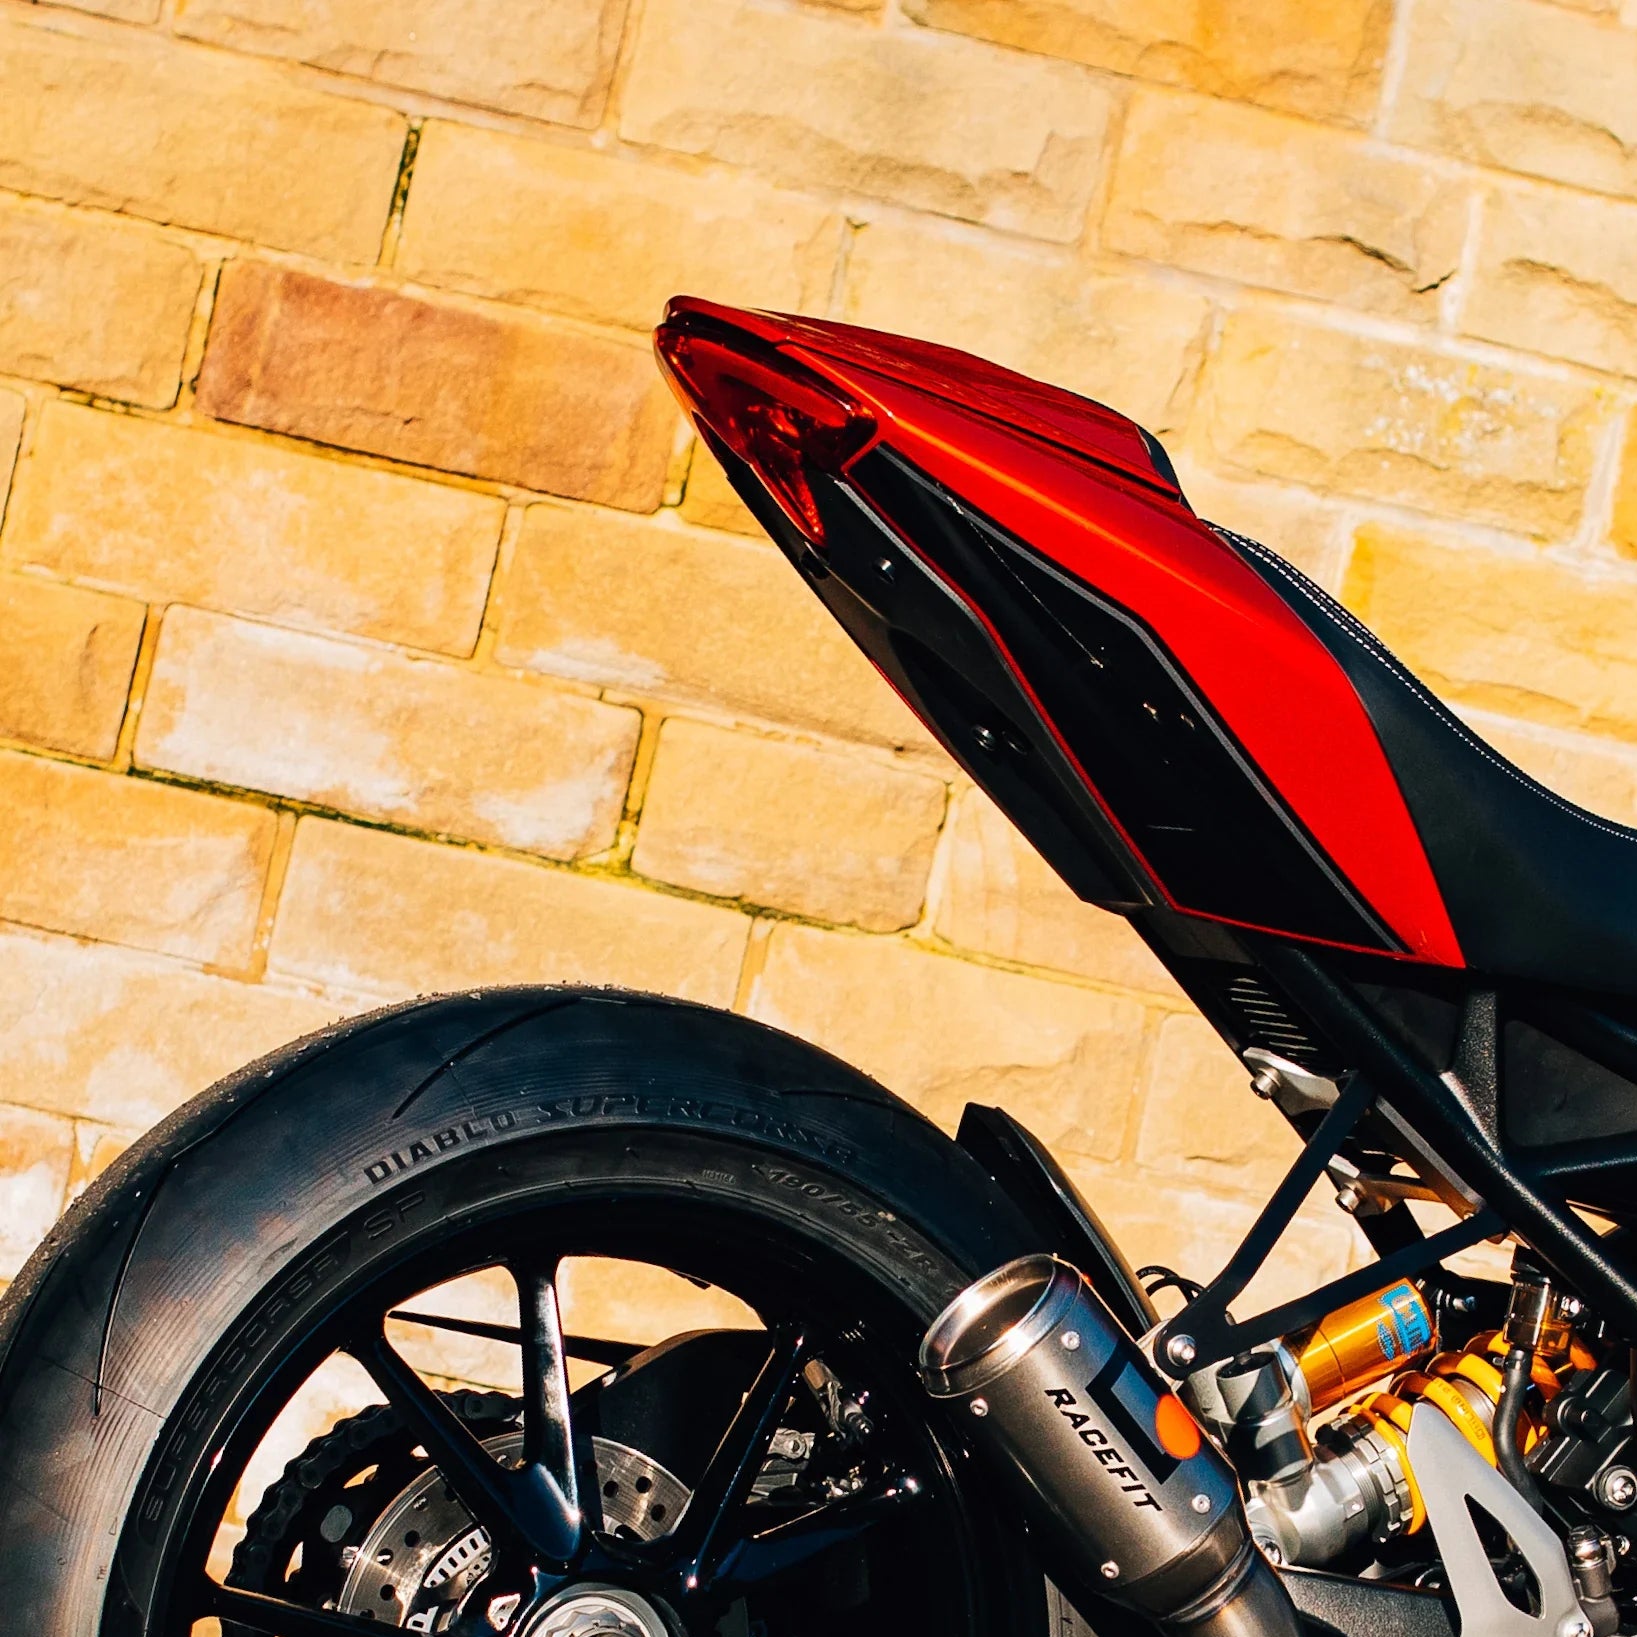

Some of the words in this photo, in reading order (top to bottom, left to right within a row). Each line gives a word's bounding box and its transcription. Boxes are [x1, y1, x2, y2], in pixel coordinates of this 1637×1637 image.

[364, 1110, 517, 1185] DIABLO
[144, 1252, 341, 1522] SUPERCORSA
[363, 1189, 426, 1241] SP
[1044, 1388, 1163, 1512] RACEFIT
